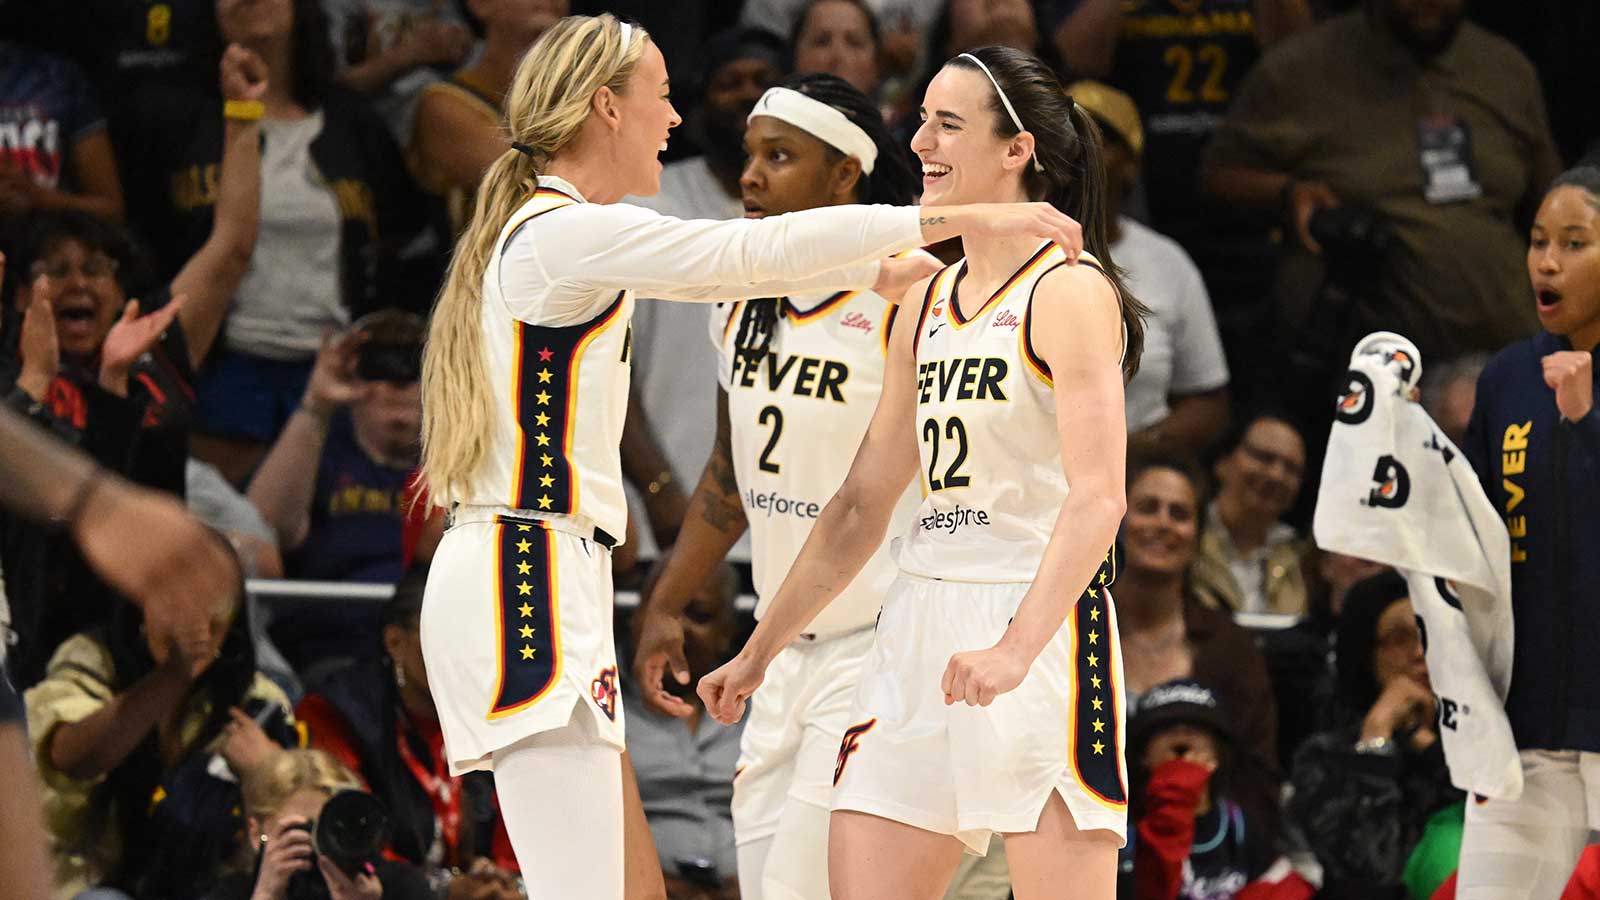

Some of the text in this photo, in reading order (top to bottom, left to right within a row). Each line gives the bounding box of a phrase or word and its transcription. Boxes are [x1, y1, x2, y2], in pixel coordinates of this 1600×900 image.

[1161, 44, 1230, 104] 22
[992, 309, 1021, 332] Lilly
[731, 351, 848, 403] FEVER
[918, 357, 1009, 404] FEVER
[758, 404, 784, 475] 2
[923, 416, 971, 492] 22
[1502, 419, 1533, 563] FEVER
